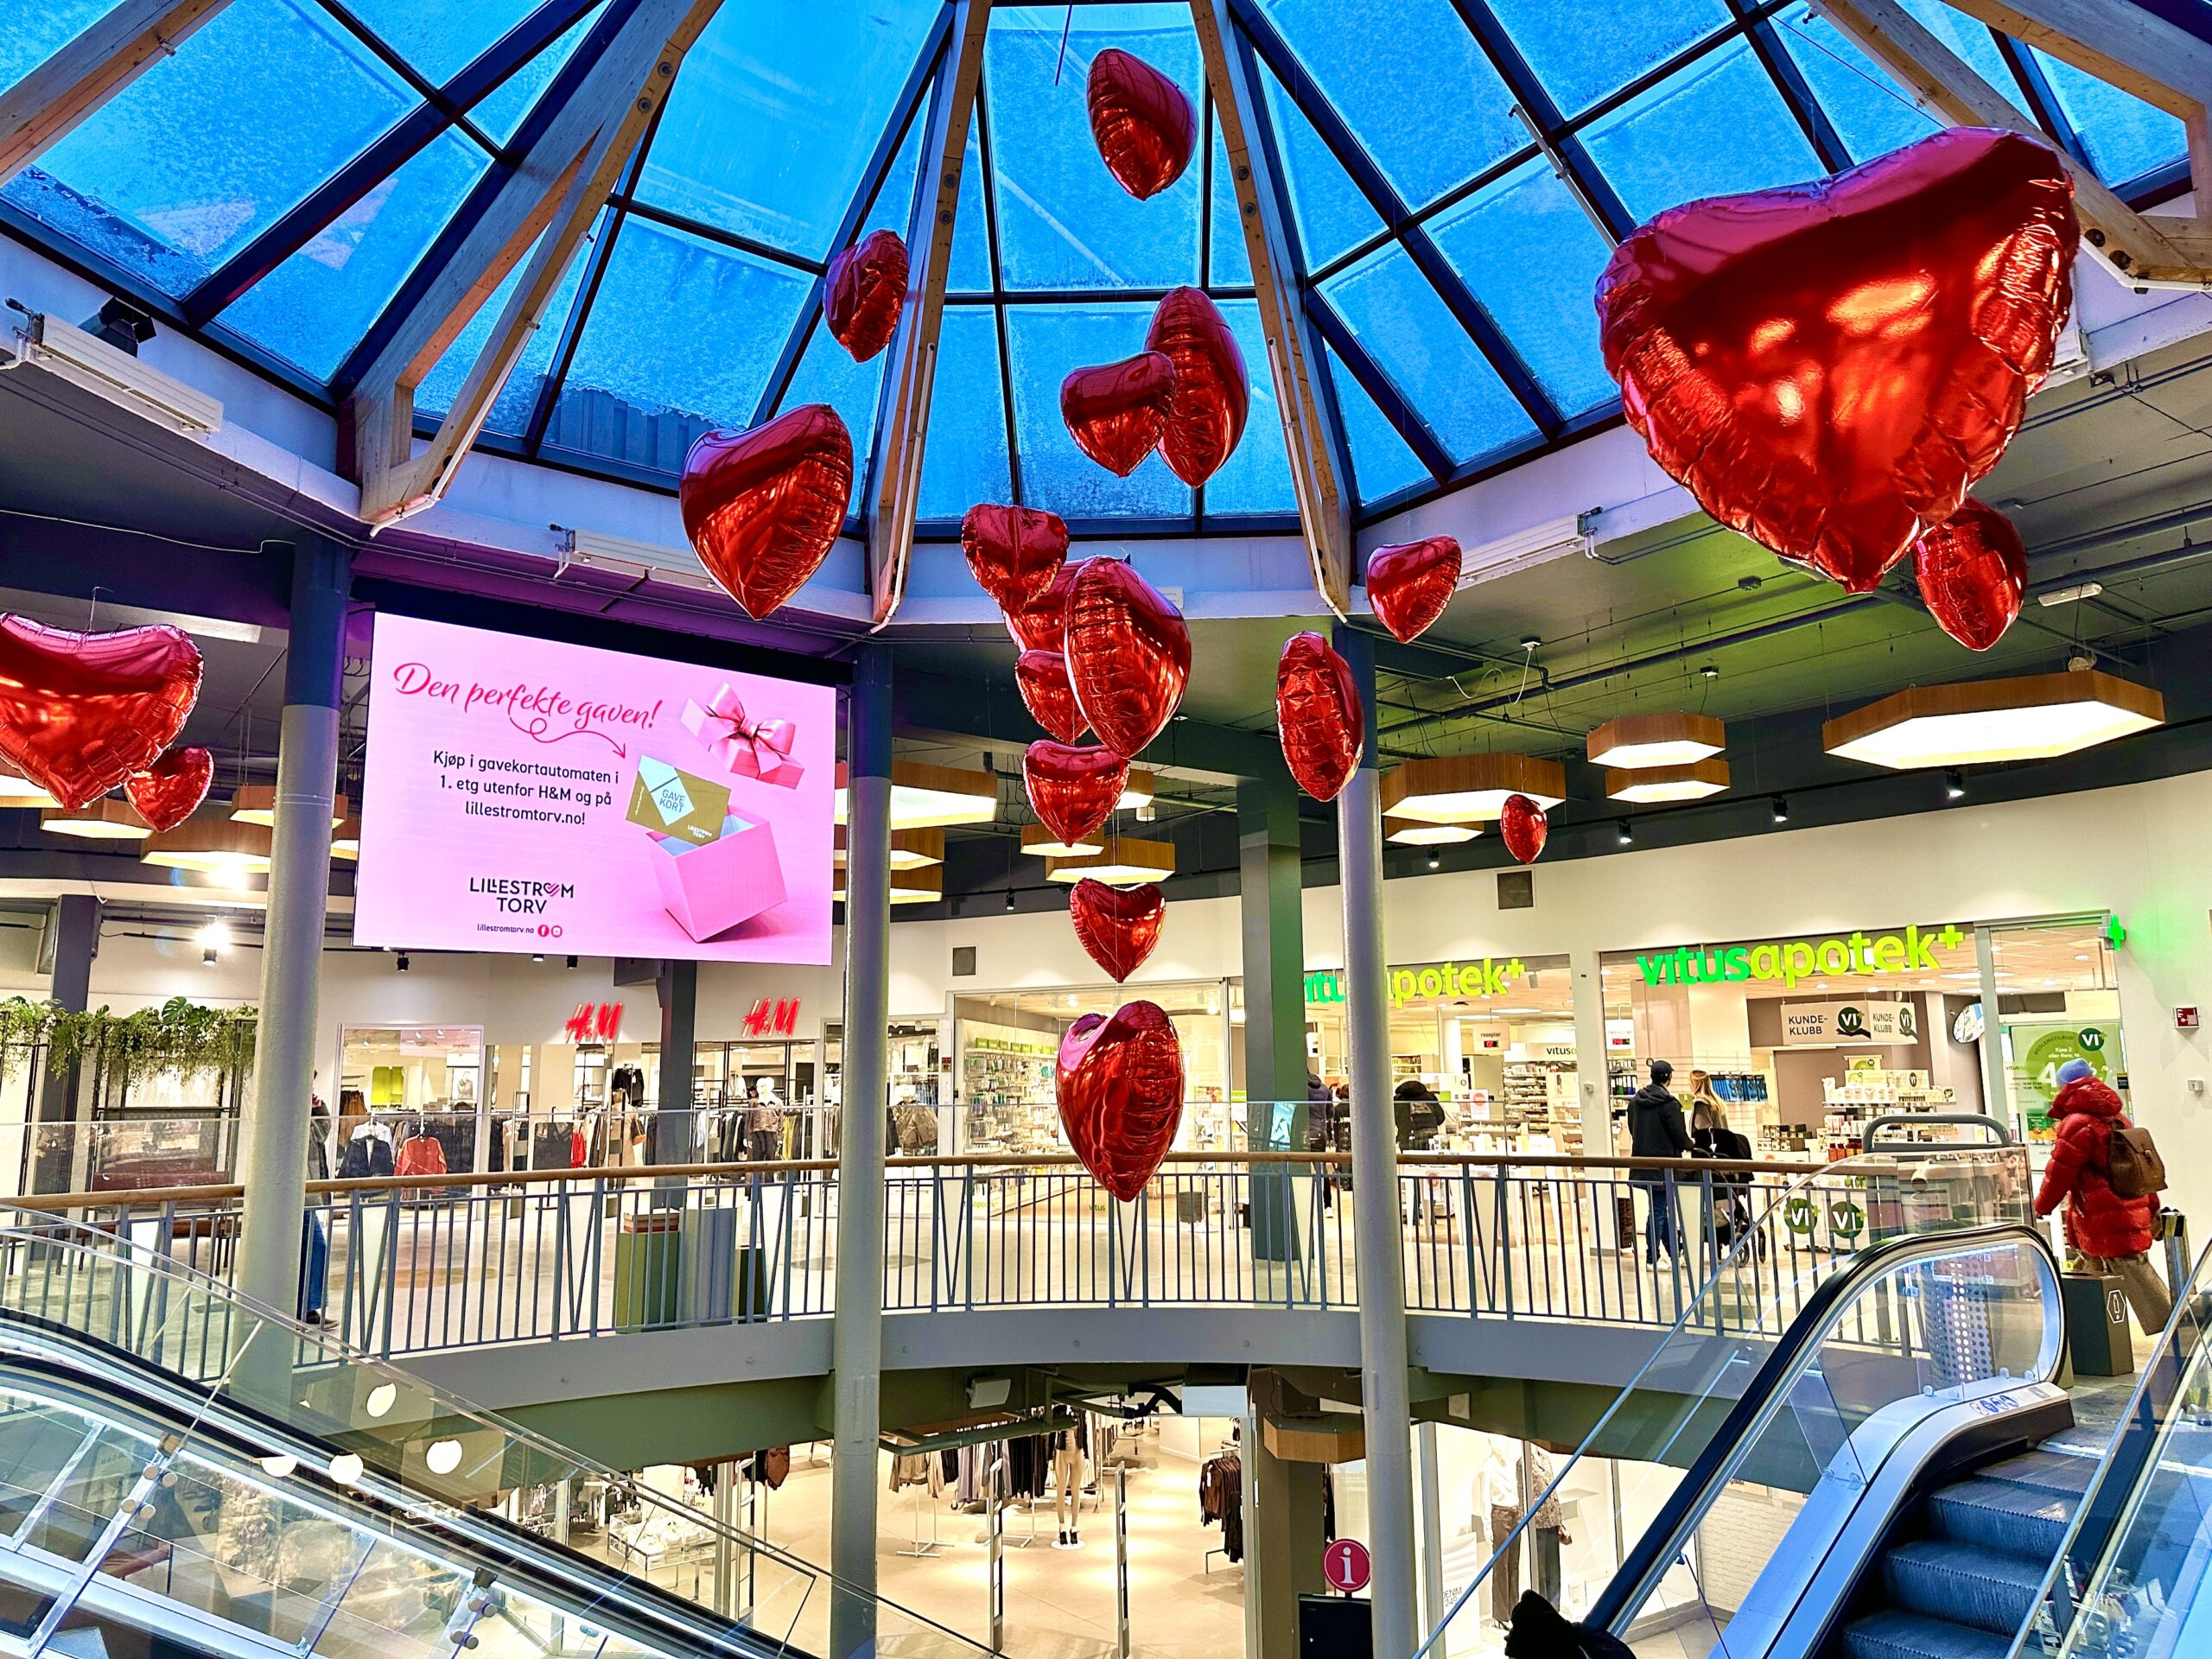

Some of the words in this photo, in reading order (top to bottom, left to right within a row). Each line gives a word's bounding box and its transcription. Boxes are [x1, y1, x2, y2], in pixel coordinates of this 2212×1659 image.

[393, 662, 460, 704] Den
[464, 683, 572, 718] perfekte
[574, 699, 663, 730] gaven!
[433, 750, 466, 769] Kjøp
[469, 754, 474, 767] i
[478, 759, 611, 784] gavekortautomaten
[614, 771, 620, 784] i
[440, 775, 453, 789] 1.
[456, 779, 479, 794] etg
[483, 782, 534, 797] utenfor
[538, 785, 571, 801] H&M
[575, 791, 592, 806] og
[595, 791, 612, 807] på
[662, 789, 686, 805] GAVE
[465, 800, 586, 825] lillestromtorv.no!
[659, 798, 684, 813] KORT
[496, 897, 548, 914] TORV
[477, 923, 535, 934] lillestromtorv.no
[564, 1001, 623, 1044] H&M
[741, 997, 801, 1039] H&M
[1788, 1014, 1828, 1025] KUNDE-
[1789, 1026, 1823, 1036] KLUBB
[1873, 1025, 1892, 1033] KLUBB
